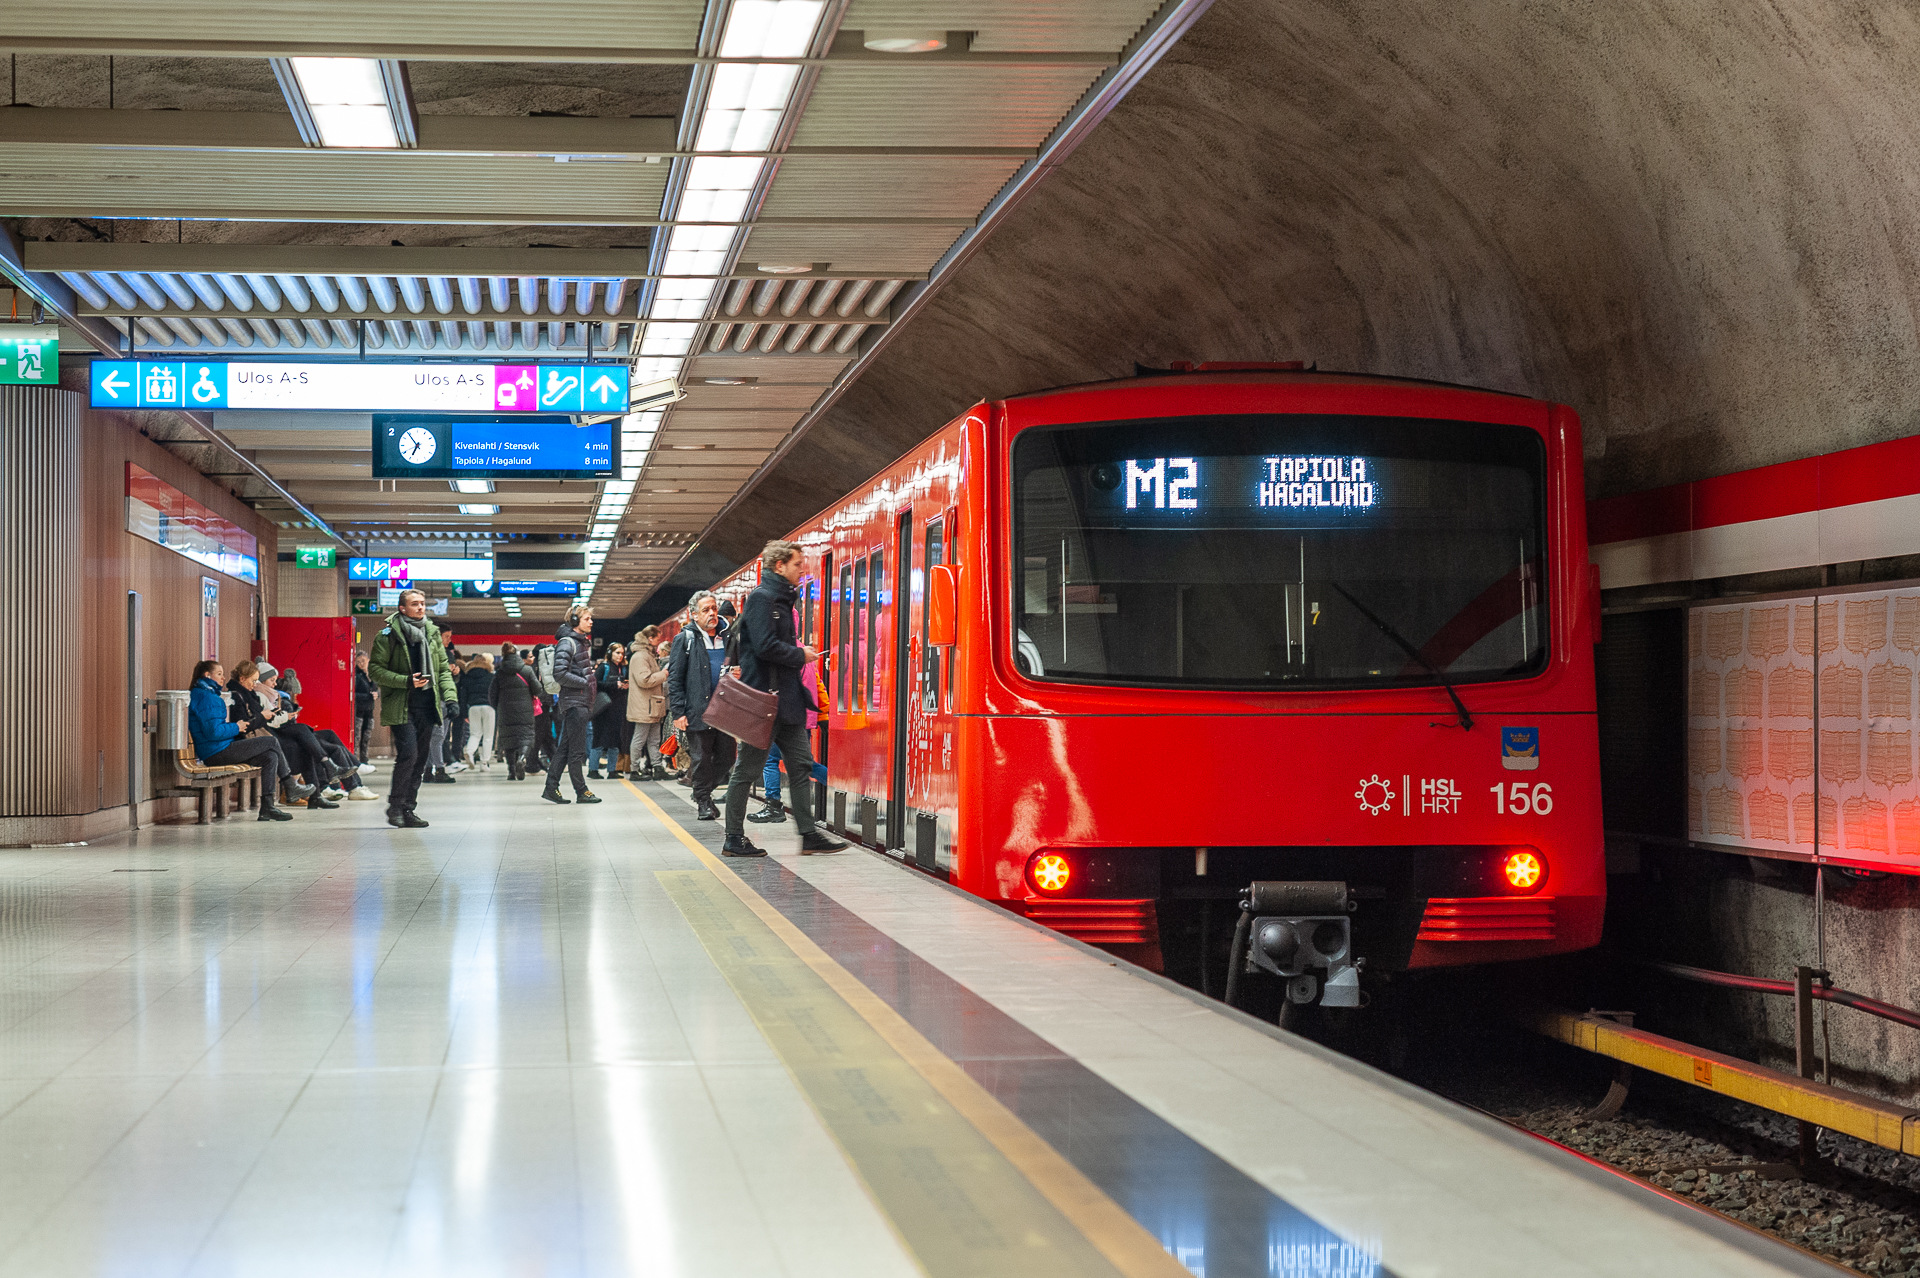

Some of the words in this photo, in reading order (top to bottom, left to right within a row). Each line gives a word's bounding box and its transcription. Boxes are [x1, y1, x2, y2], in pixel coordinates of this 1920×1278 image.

[238, 371, 273, 384] Ulos
[280, 371, 309, 384] A-S
[414, 373, 450, 386] Ulos
[456, 373, 485, 386] A-S
[388, 428, 395, 437] 2
[454, 441, 497, 450] Kivenlahti
[498, 442, 503, 451] /
[503, 441, 540, 450] Stensvik
[584, 442, 591, 450] 4
[592, 442, 609, 451] min
[454, 456, 484, 466] Tapiola
[485, 456, 490, 466] /
[491, 456, 532, 467] Hagalund
[584, 457, 591, 465] 8
[592, 457, 609, 465] min
[1266, 457, 1366, 482] TAPIOLA
[1126, 457, 1198, 509] M2
[1259, 482, 1375, 508] HAGALUND
[1421, 779, 1462, 796] HSL
[1421, 797, 1462, 814] HRT
[1490, 782, 1553, 816] 156
